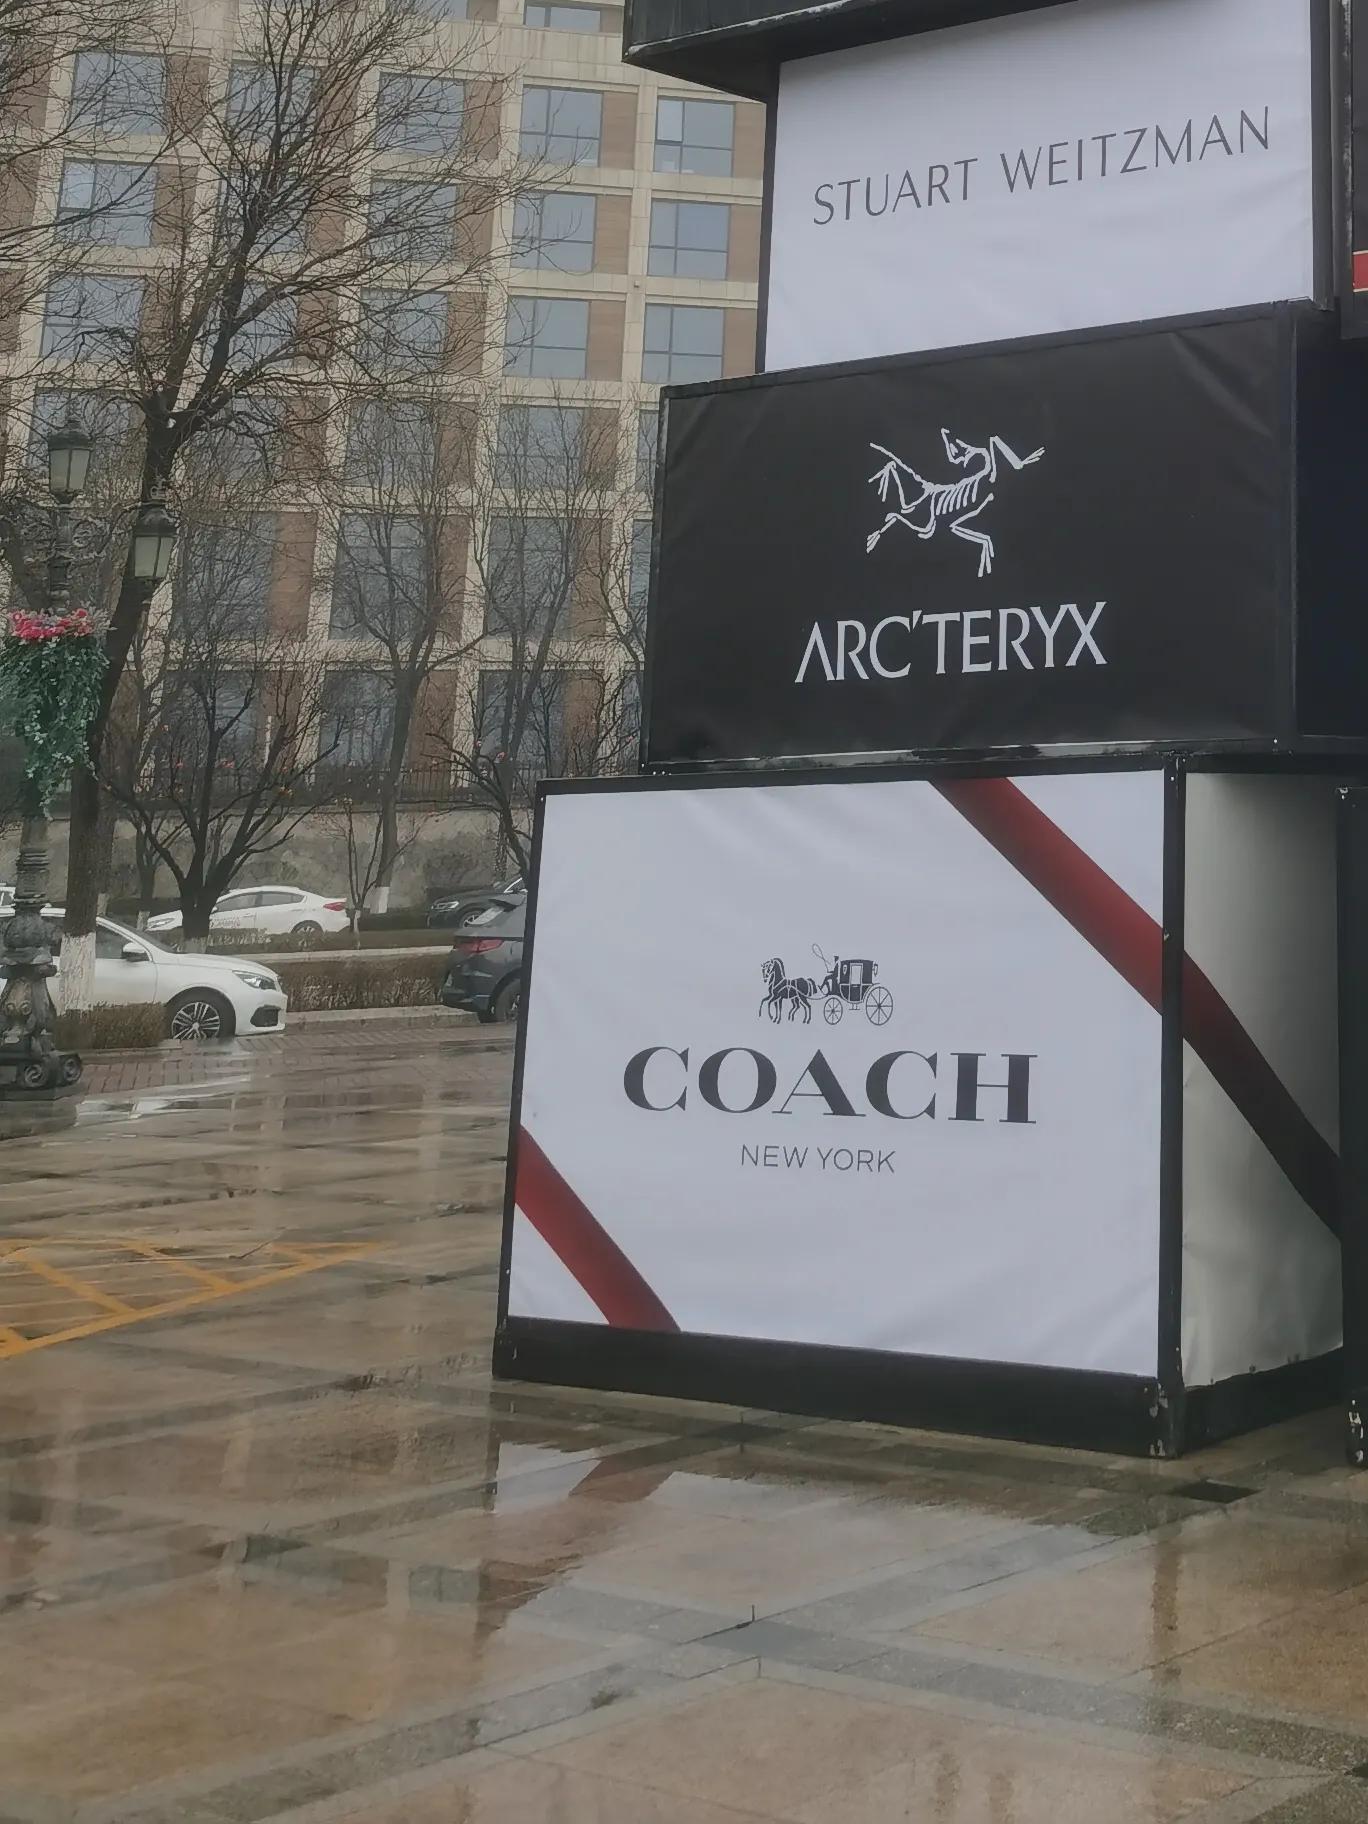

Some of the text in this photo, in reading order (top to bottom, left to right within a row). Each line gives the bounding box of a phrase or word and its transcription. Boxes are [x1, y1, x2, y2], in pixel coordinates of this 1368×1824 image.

[812, 105, 1270, 226] STUART WEITZMAN
[794, 601, 1108, 683] ARC'TERYX
[623, 1046, 1039, 1125] COACH
[740, 1143, 896, 1174] NEW YORK
